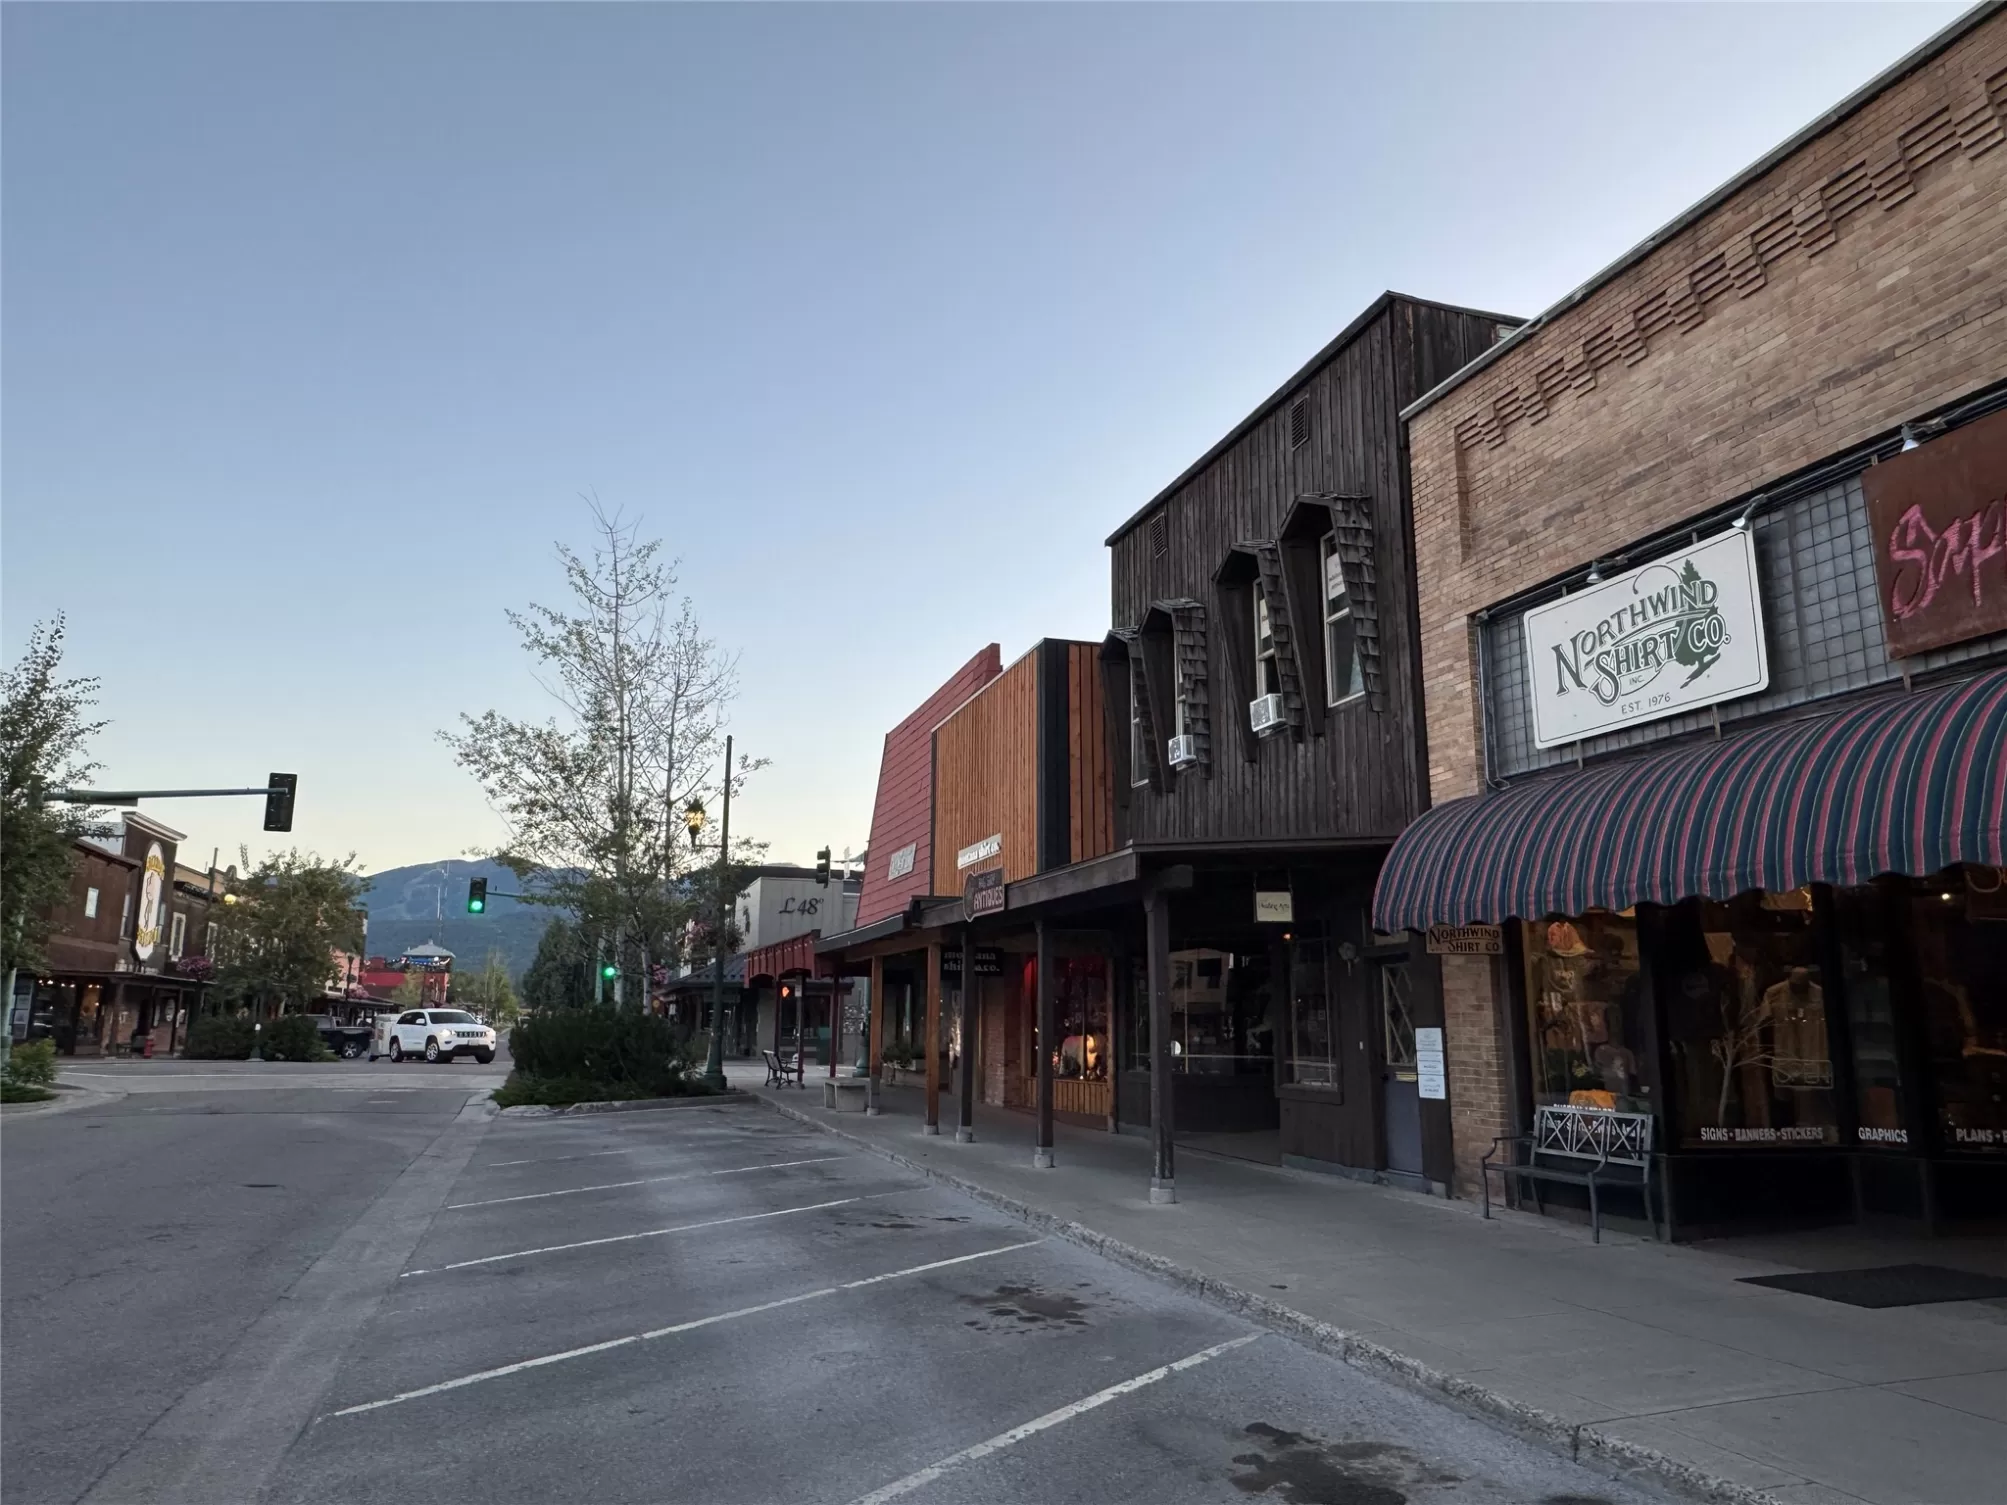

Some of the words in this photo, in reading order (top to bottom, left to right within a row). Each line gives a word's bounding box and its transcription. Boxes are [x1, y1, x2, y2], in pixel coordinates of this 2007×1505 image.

[1551, 580, 1717, 696] NORTHWIND
[1589, 627, 1680, 706] SHIRT
[1687, 613, 1732, 652] CO.
[1621, 701, 1643, 714] EST.
[1649, 692, 1671, 707] 1976
[973, 886, 1003, 911] ANTIQUES
[1429, 926, 1500, 944] NORTHWIND
[1447, 941, 1480, 952] SHIRT
[1485, 941, 1500, 952] CO
[944, 952, 997, 960] moana
[1700, 1127, 1729, 1141] SIGNS
[1734, 1128, 1777, 1141] BANNERS
[1781, 1127, 1823, 1141] STICKERS
[1858, 1126, 1908, 1143] GRAPHICS
[1955, 1127, 1994, 1143] PLANS
